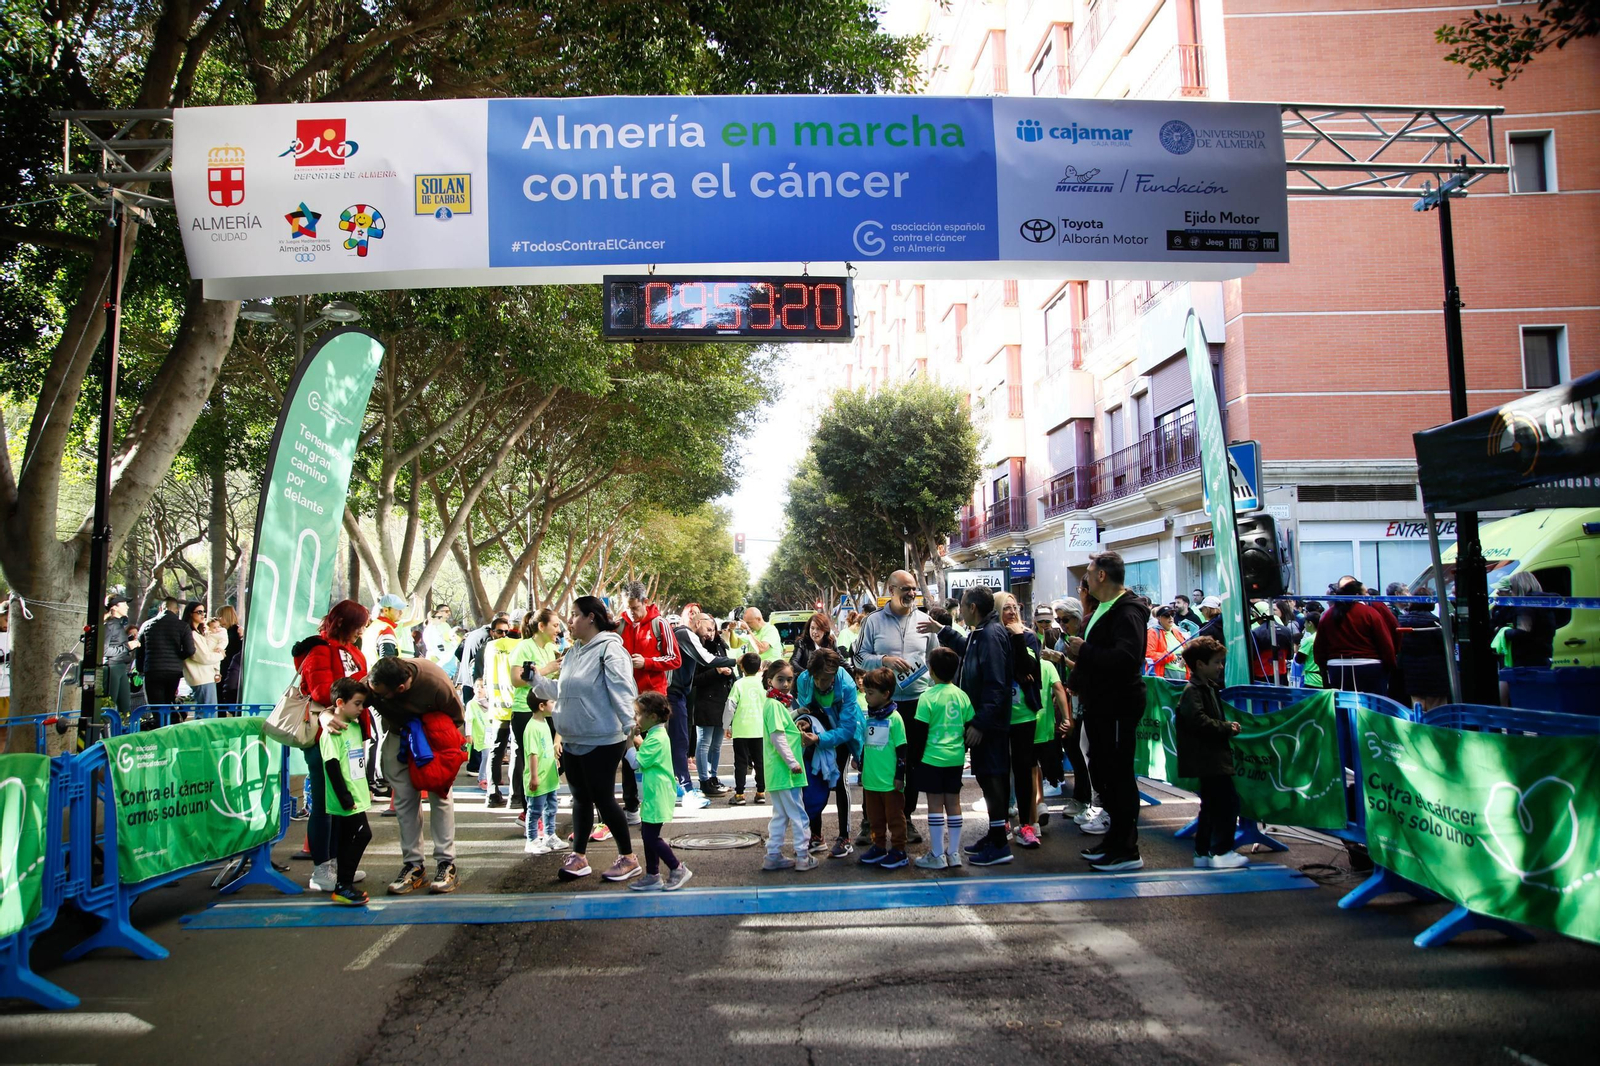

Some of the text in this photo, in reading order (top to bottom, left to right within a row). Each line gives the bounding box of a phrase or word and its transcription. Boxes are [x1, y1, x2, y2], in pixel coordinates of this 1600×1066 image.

[521, 114, 965, 151] Almería en marcha
[1049, 122, 1133, 144] cajamar
[1195, 129, 1266, 140] UNIVERSIDAD
[1197, 138, 1267, 150] DE ALMERÍA
[293, 171, 341, 181] DEPORTES
[343, 171, 356, 179] DE
[522, 162, 909, 202] contra el cáncer
[1055, 173, 1229, 195] MICHELIN Fundación
[421, 194, 466, 205] DE CABRAS
[191, 212, 262, 232] ALMERÍA
[1061, 218, 1104, 230] Toyota
[1184, 210, 1260, 226] Ejido Motor
[890, 221, 986, 235] asociación española
[211, 232, 248, 242] CIUDAD
[892, 232, 967, 243] contra el cáncer
[1062, 232, 1149, 245] Alborán Motor
[1205, 238, 1225, 248] Jeep
[1228, 238, 1243, 250] FIAT
[1262, 238, 1276, 250] FIAT
[279, 243, 331, 253] Almería 2005
[511, 238, 666, 253] #TodosContraElCáncer
[893, 243, 946, 253] en Almería
[1545, 396, 1600, 439] cru
[299, 422, 343, 461] Tenemos
[294, 440, 331, 472] un gran
[290, 455, 328, 485] camino
[287, 471, 306, 488] por
[284, 486, 324, 516] delante
[1069, 523, 1094, 535] ENTRE
[1068, 534, 1095, 548] FUEGOS
[120, 780, 215, 808] Contra el cáncer
[162, 800, 188, 820] solo
[188, 799, 209, 815] uno
[1414, 792, 1428, 811] el
[1426, 798, 1477, 827] cáncer
[1408, 814, 1443, 838] solo
[1445, 825, 1475, 848] uno
